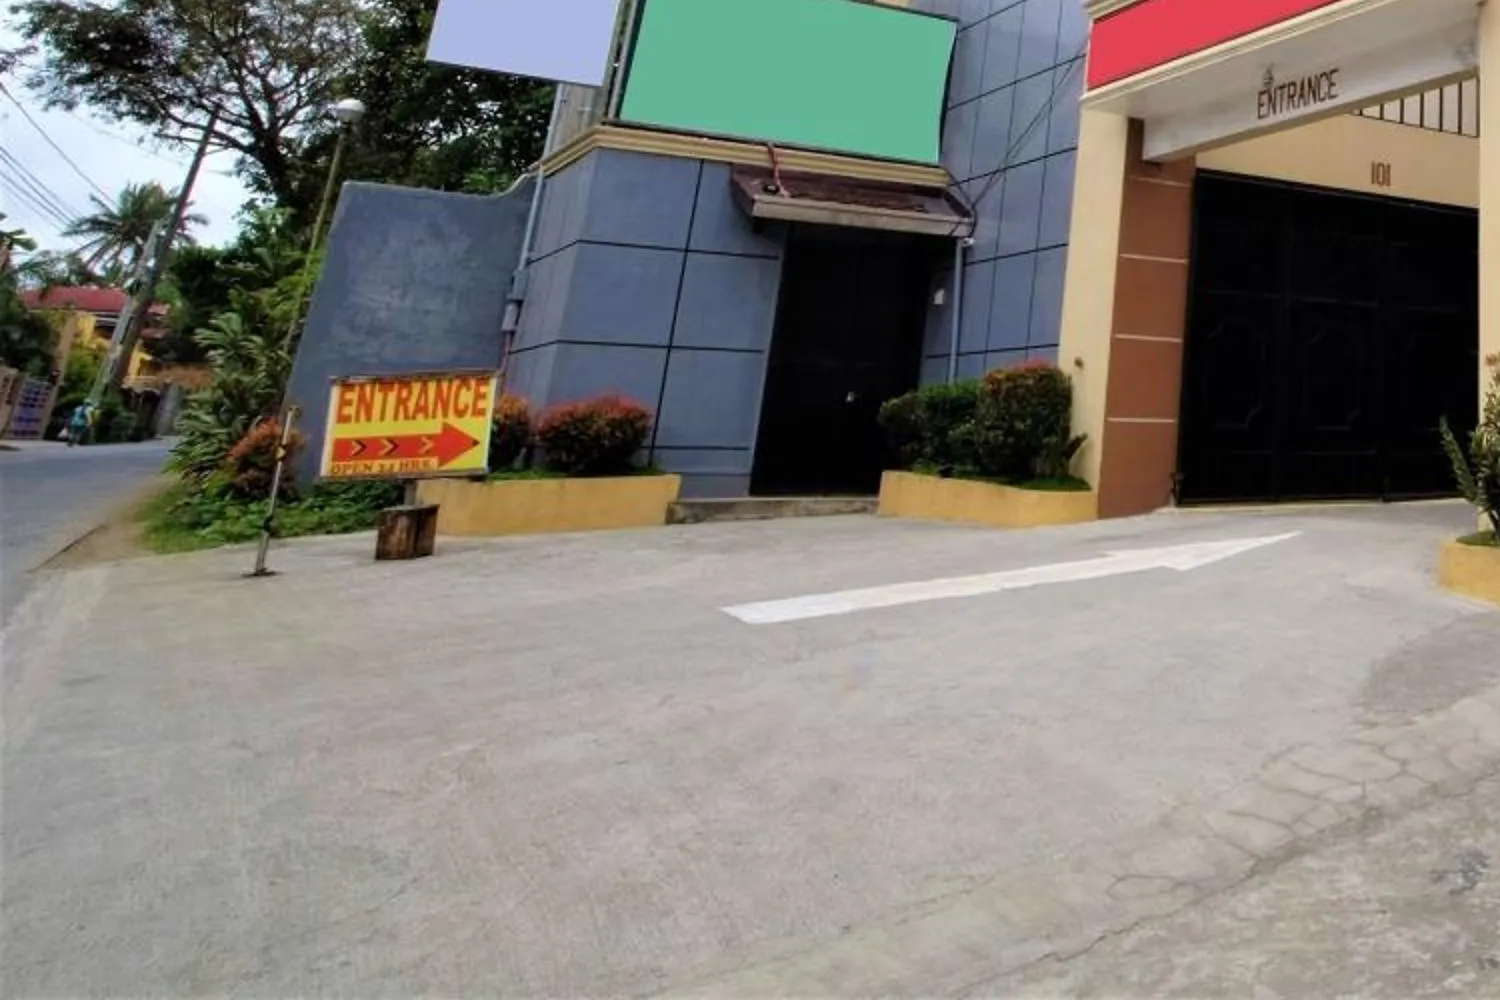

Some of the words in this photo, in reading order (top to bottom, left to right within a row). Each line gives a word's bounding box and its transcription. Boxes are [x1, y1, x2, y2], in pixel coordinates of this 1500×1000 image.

[1257, 68, 1340, 120] ENTRANCE
[336, 375, 489, 424] ENTRANCE
[331, 462, 373, 474] OPEN
